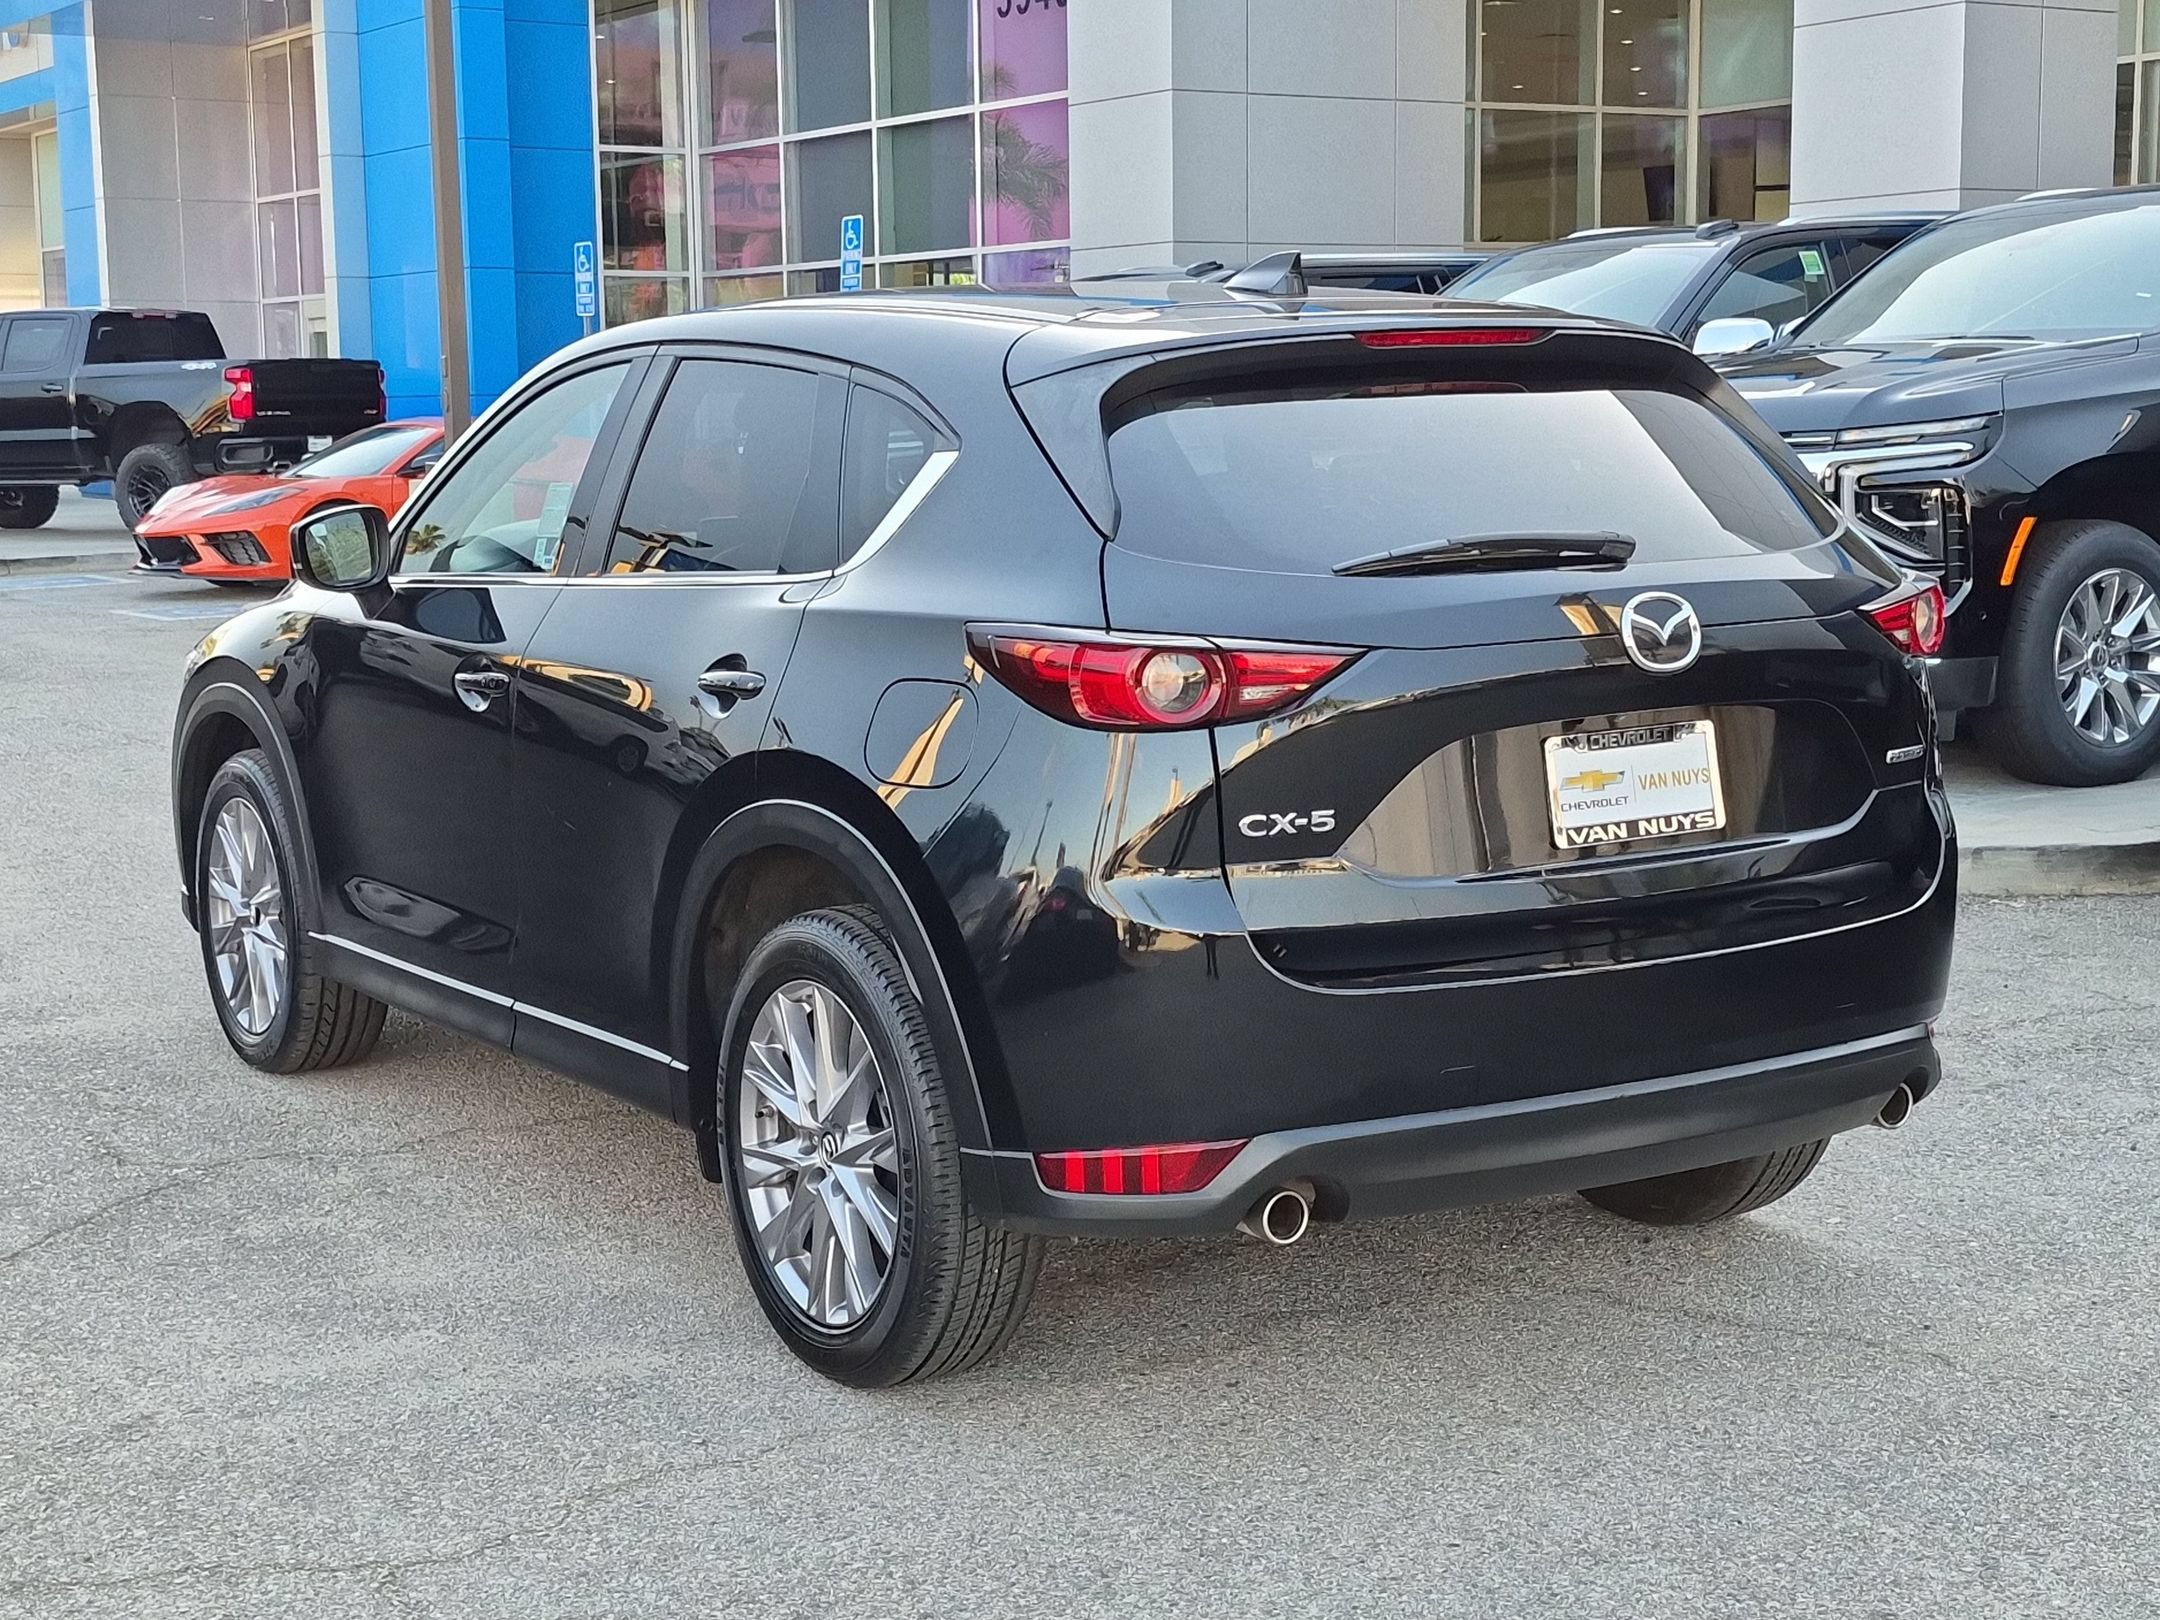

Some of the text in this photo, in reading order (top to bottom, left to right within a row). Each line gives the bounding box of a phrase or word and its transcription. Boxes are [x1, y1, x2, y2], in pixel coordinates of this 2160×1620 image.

[1589, 727, 1671, 750] CHEVROLET
[1638, 767, 1711, 791] VAN NUYS
[1560, 796, 1630, 812] CHEVROLET
[1238, 808, 1336, 838] CX-5
[1567, 811, 1716, 845] VAN NUYS
